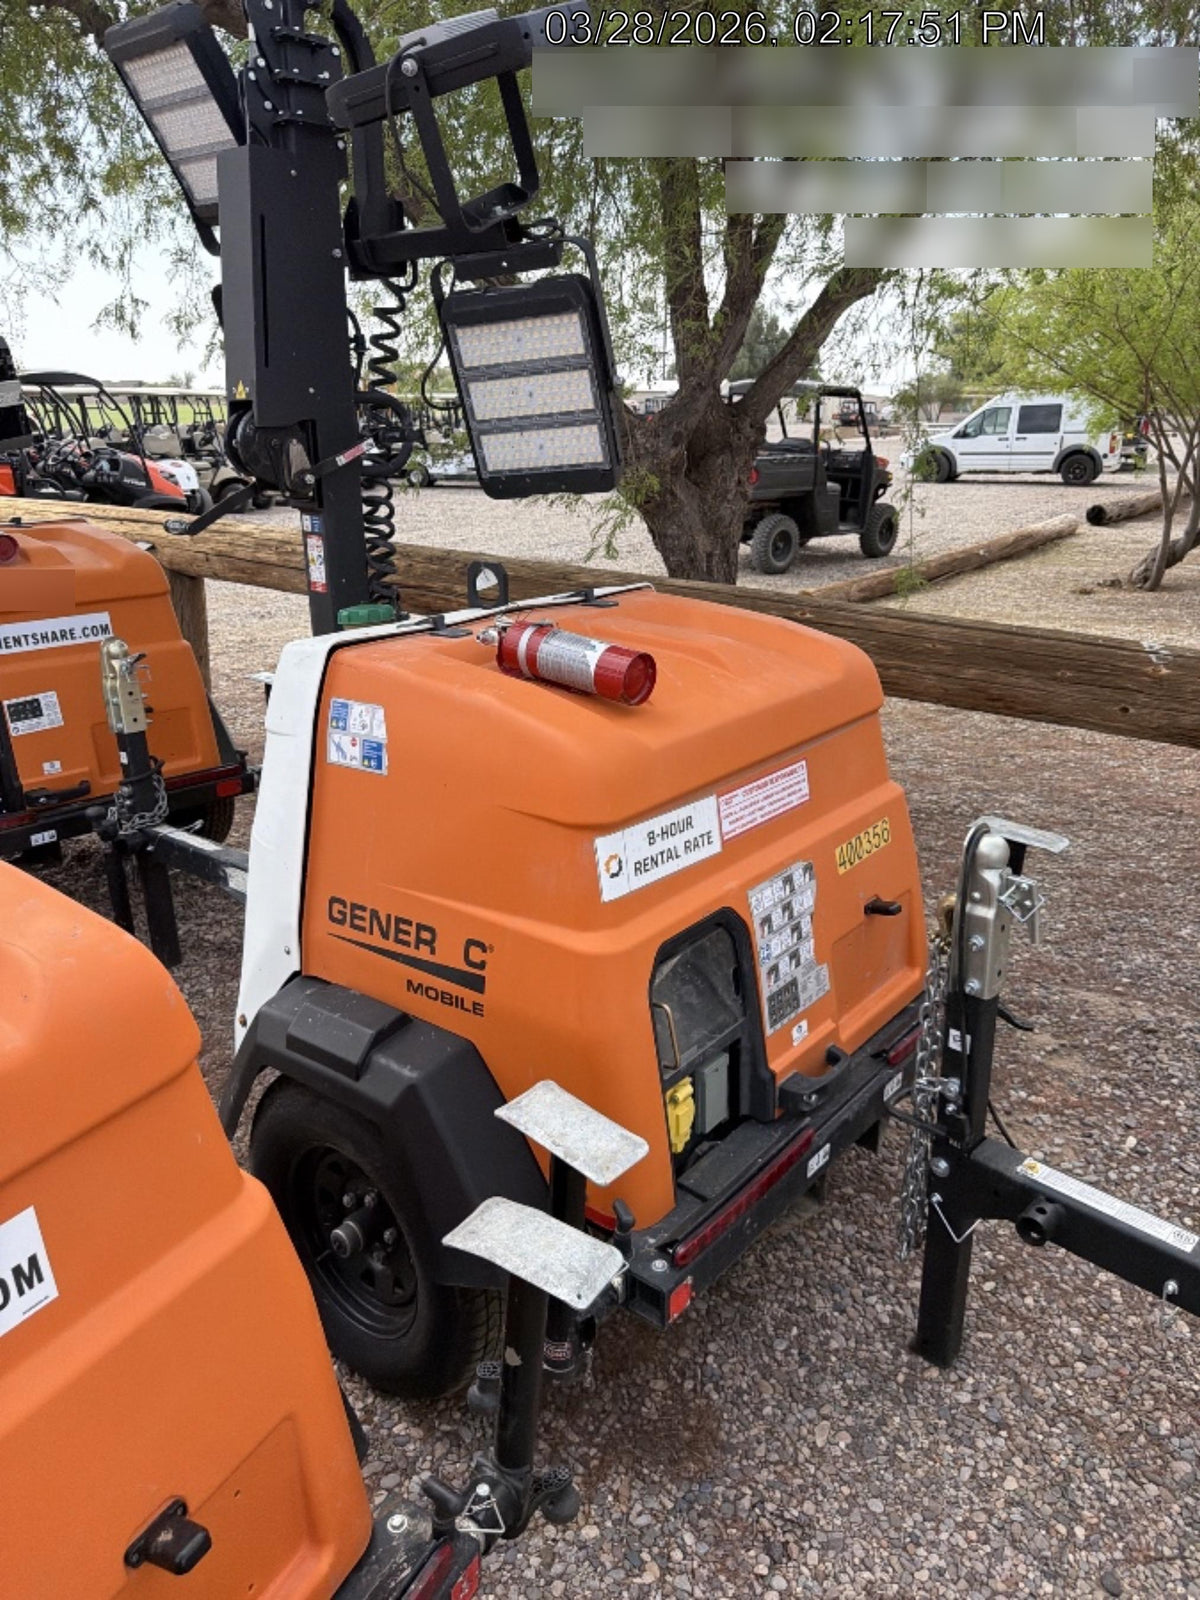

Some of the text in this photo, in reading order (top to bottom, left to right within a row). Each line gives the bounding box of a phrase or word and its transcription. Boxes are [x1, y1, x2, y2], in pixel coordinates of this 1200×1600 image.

[0, 623, 110, 650] ENTSHARE.COM
[647, 815, 694, 846] 8-HOUR
[838, 819, 890, 870] 400356
[634, 830, 714, 877] RENTAL RATE
[406, 978, 485, 1017] MOBILE
